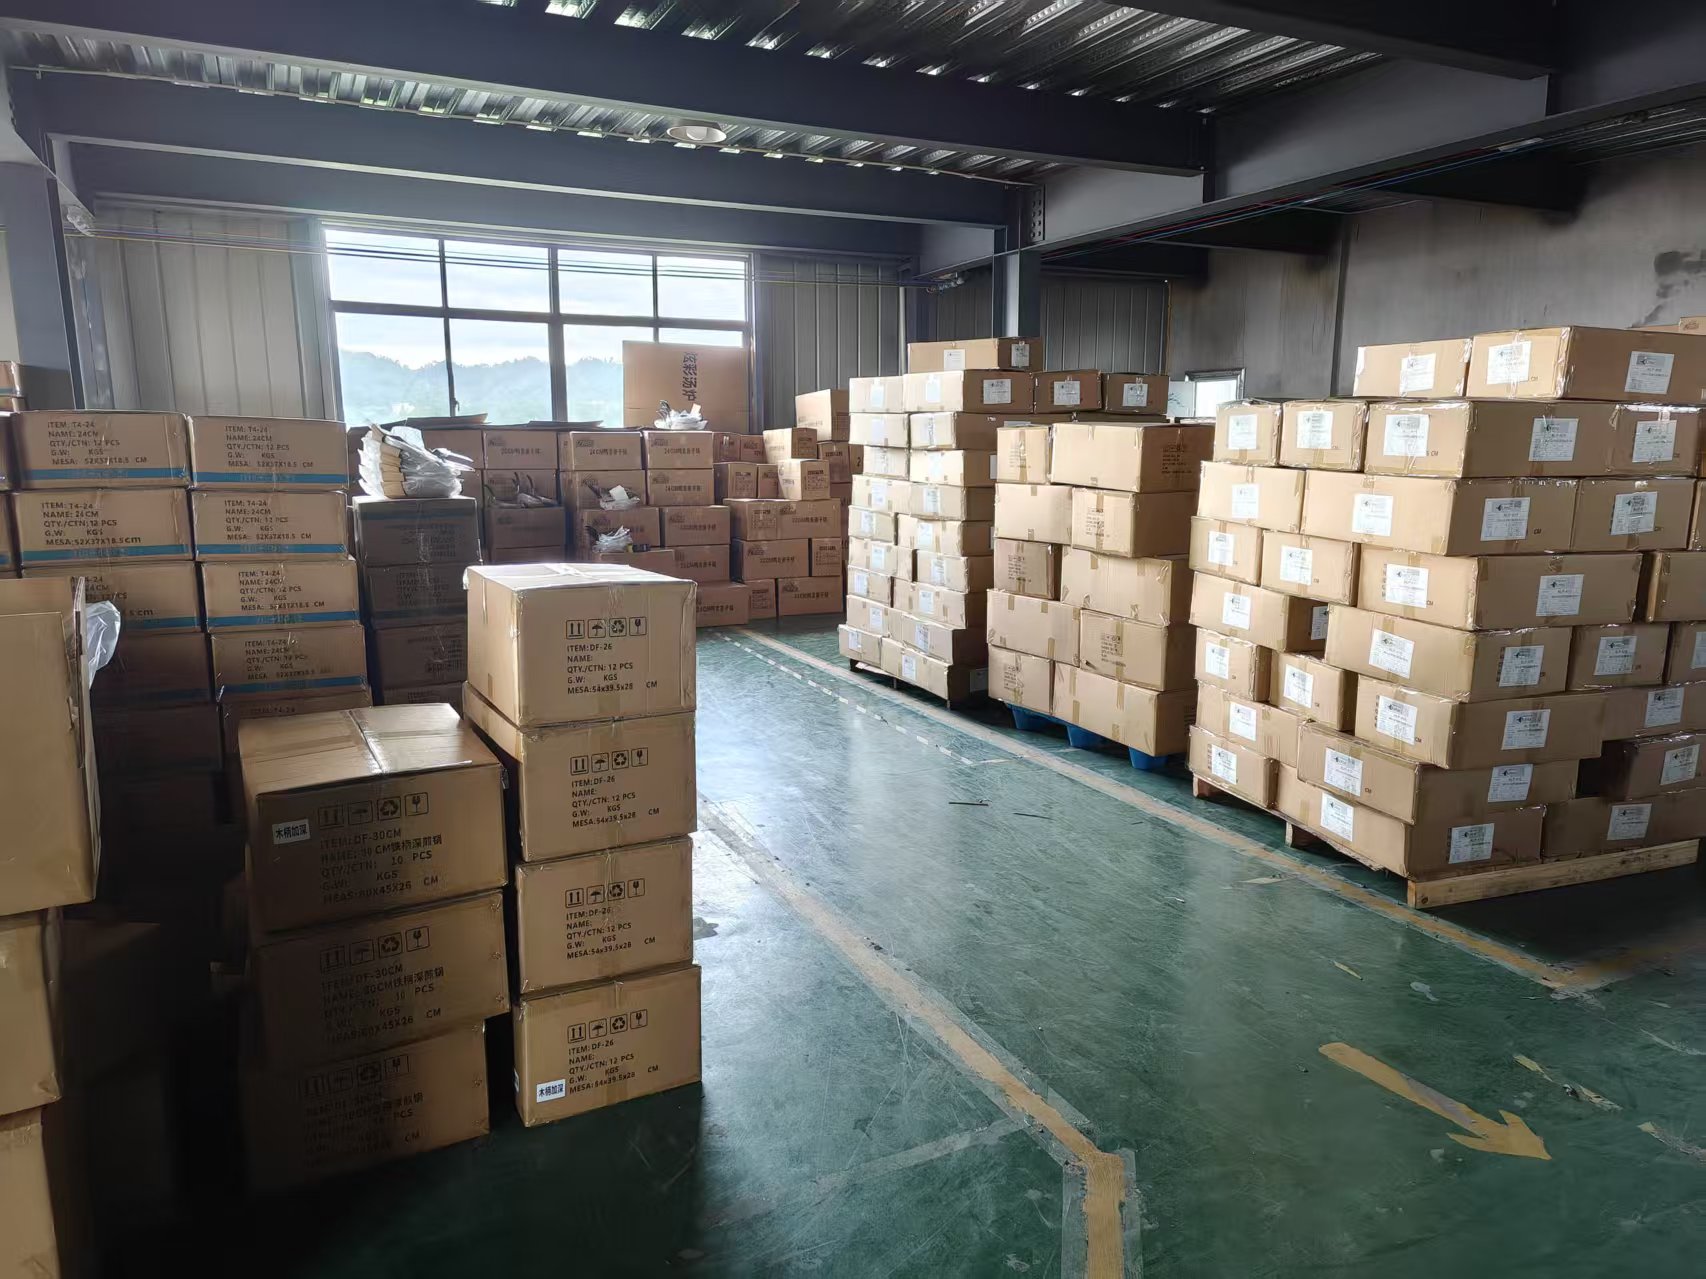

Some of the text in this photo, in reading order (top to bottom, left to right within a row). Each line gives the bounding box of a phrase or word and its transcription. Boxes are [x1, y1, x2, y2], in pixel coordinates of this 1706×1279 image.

[48, 421, 71, 429] ITEM:
[48, 430, 75, 438] NAME:
[101, 519, 117, 527] PCS
[567, 655, 593, 663] NAME:
[567, 662, 634, 674] QTY./CTN: 12 PCS
[567, 673, 618, 684] G.W: KGS
[646, 680, 658, 689] CM
[571, 789, 598, 798] NAME:
[611, 794, 621, 802] 12
[622, 792, 636, 801] PCS
[572, 804, 621, 818] G.W: KGS
[648, 807, 660, 816] CM
[391, 856, 404, 866] 10
[412, 850, 432, 861] PCS
[376, 871, 398, 881] KGS
[423, 876, 438, 886] CM
[566, 920, 593, 930] NAME:
[566, 927, 605, 940] QTY./CTN:
[618, 922, 632, 931] PCS
[566, 934, 617, 949] G.W: KGS
[644, 936, 656, 945] CM
[414, 984, 435, 996] PCS
[426, 1007, 441, 1019] CM
[568, 1054, 595, 1065] NAME:
[569, 1054, 634, 1074] QTY./CTN: 12 PCS
[647, 1065, 659, 1073] CM
[569, 1066, 620, 1084] G.W: KGS
